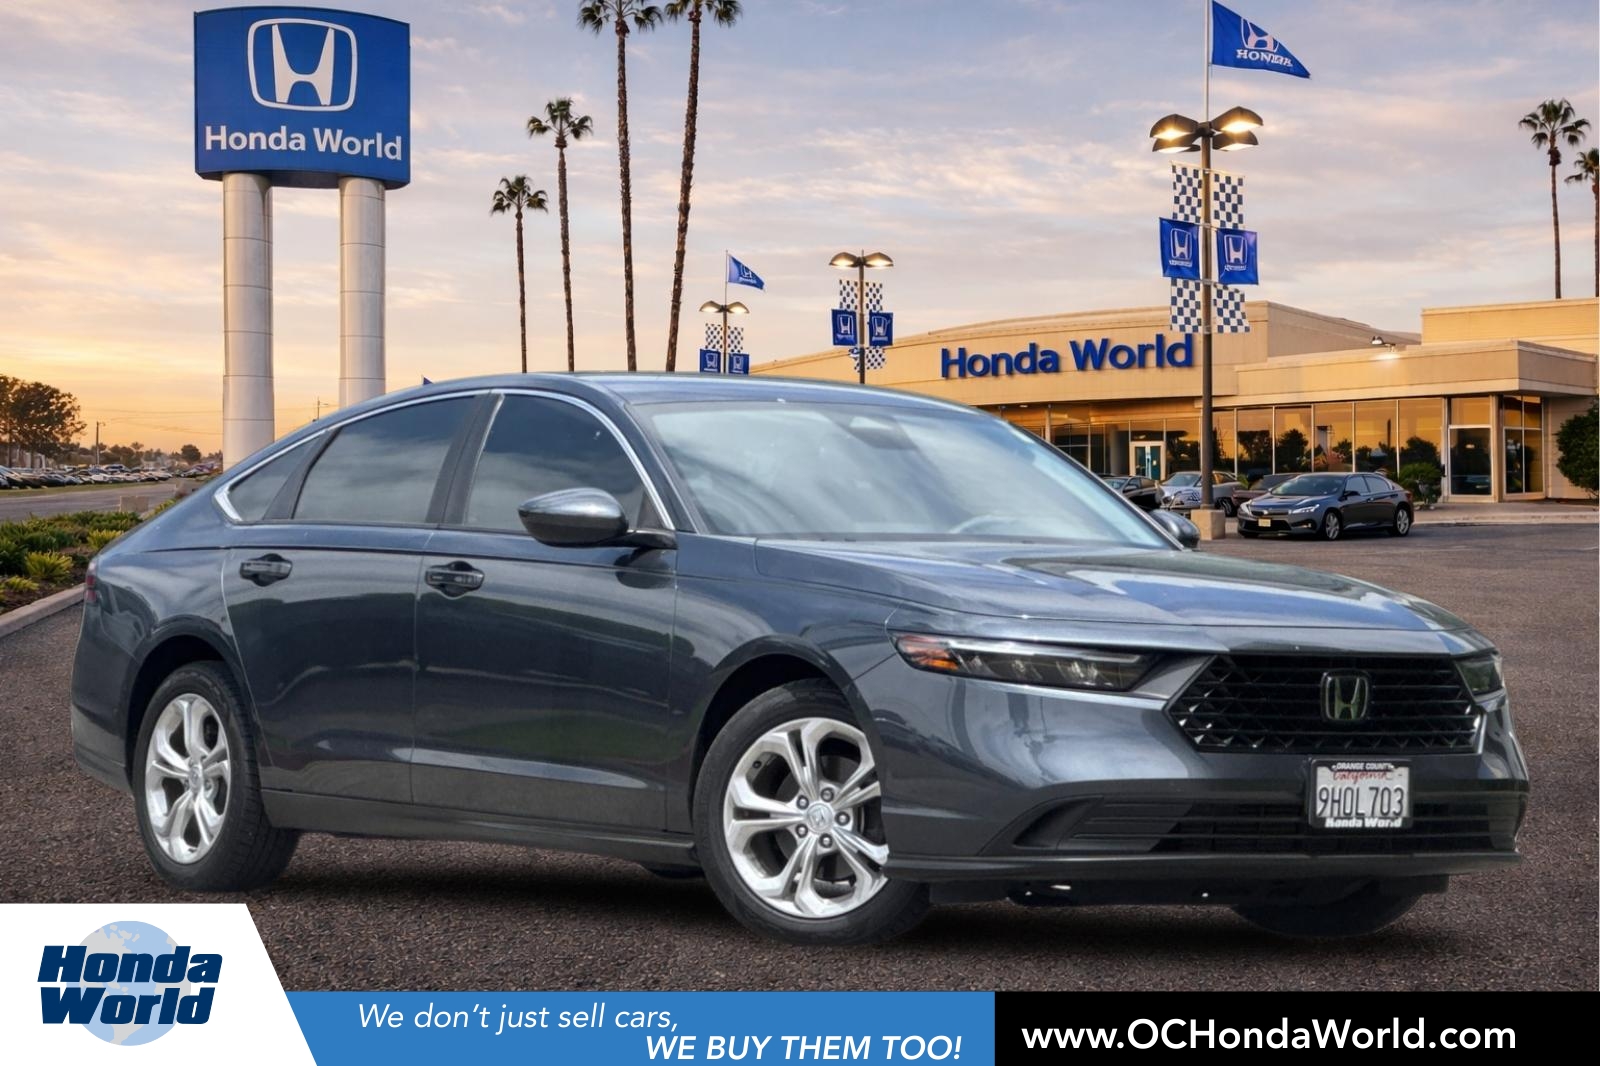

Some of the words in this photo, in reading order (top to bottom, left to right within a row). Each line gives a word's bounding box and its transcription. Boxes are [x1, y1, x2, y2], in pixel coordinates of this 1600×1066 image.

[205, 125, 306, 151] Honda
[313, 127, 402, 161] World
[941, 342, 1060, 379] Honda
[1069, 333, 1194, 372] World
[1324, 817, 1363, 828] Honda
[1364, 817, 1403, 828] World
